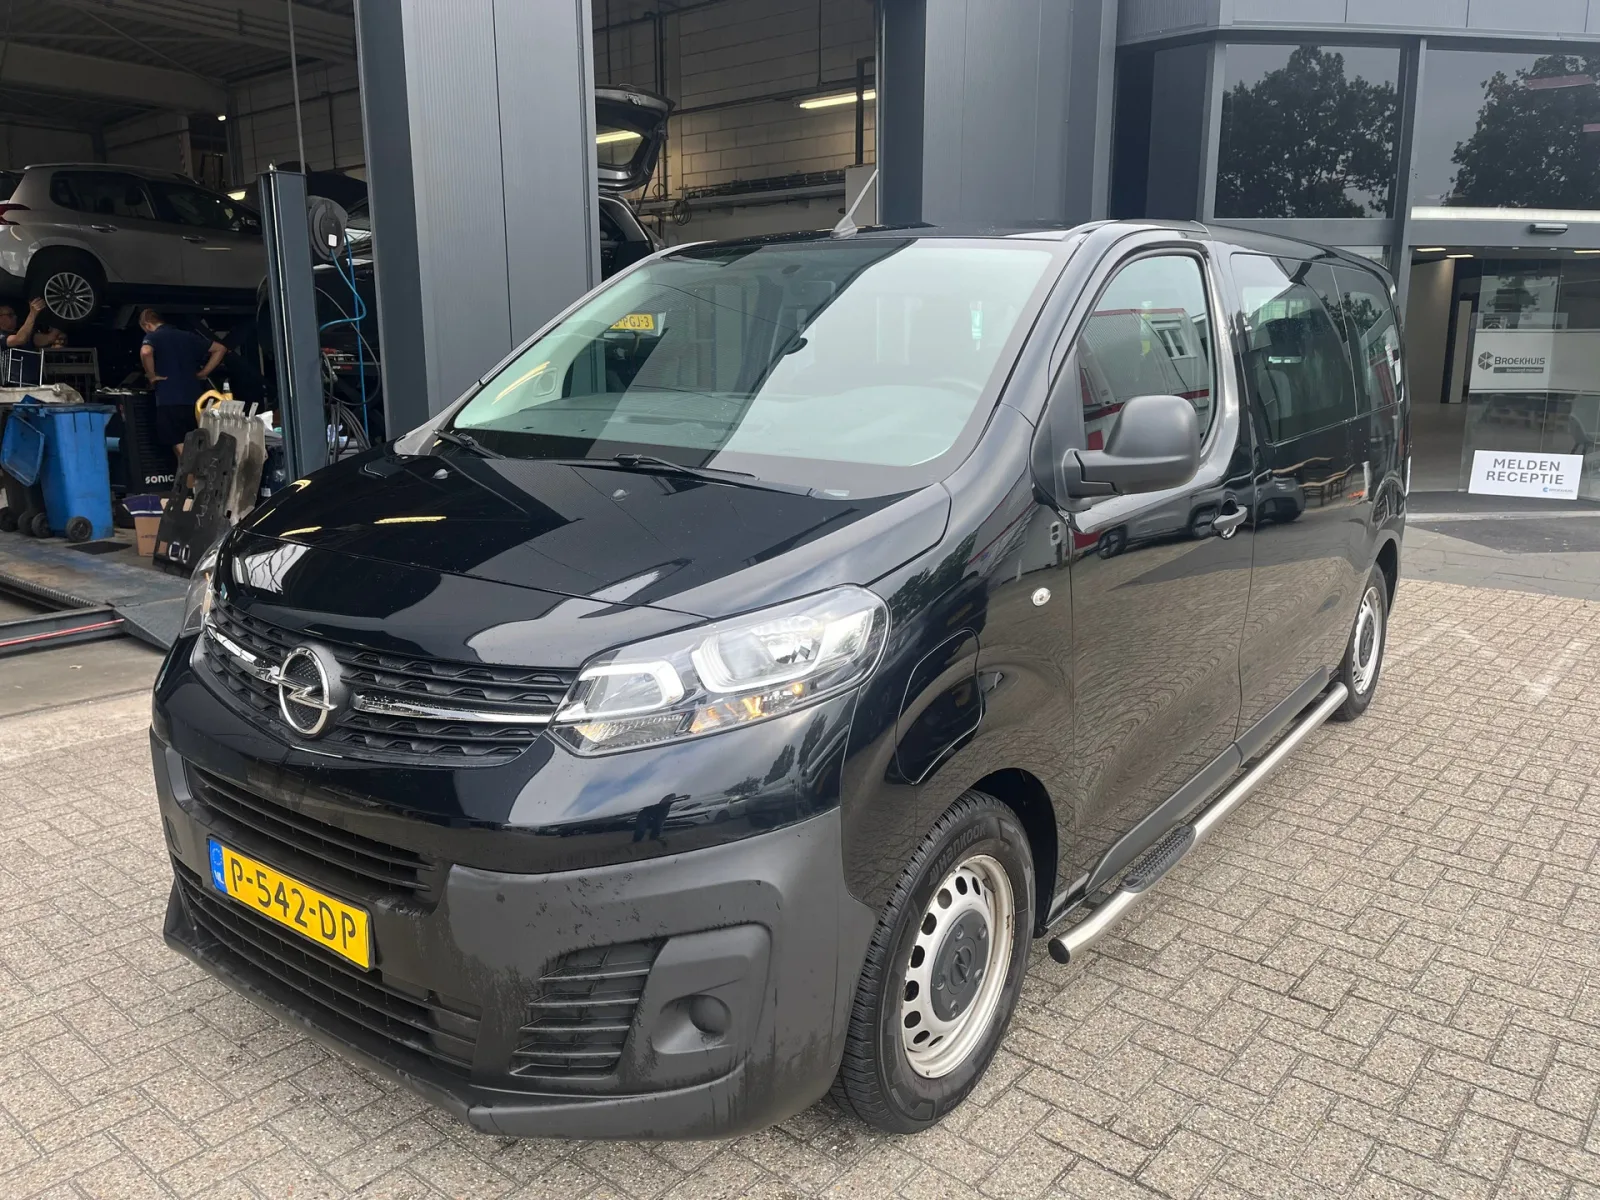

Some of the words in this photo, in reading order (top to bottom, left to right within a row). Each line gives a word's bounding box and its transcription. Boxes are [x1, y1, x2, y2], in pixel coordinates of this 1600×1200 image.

[1494, 356, 1546, 365] BROEKHUIS
[1493, 458, 1561, 472] MELDEN
[1486, 470, 1565, 485] RECEPTIE
[213, 869, 225, 885] NL
[230, 857, 357, 950] P-542-DP
